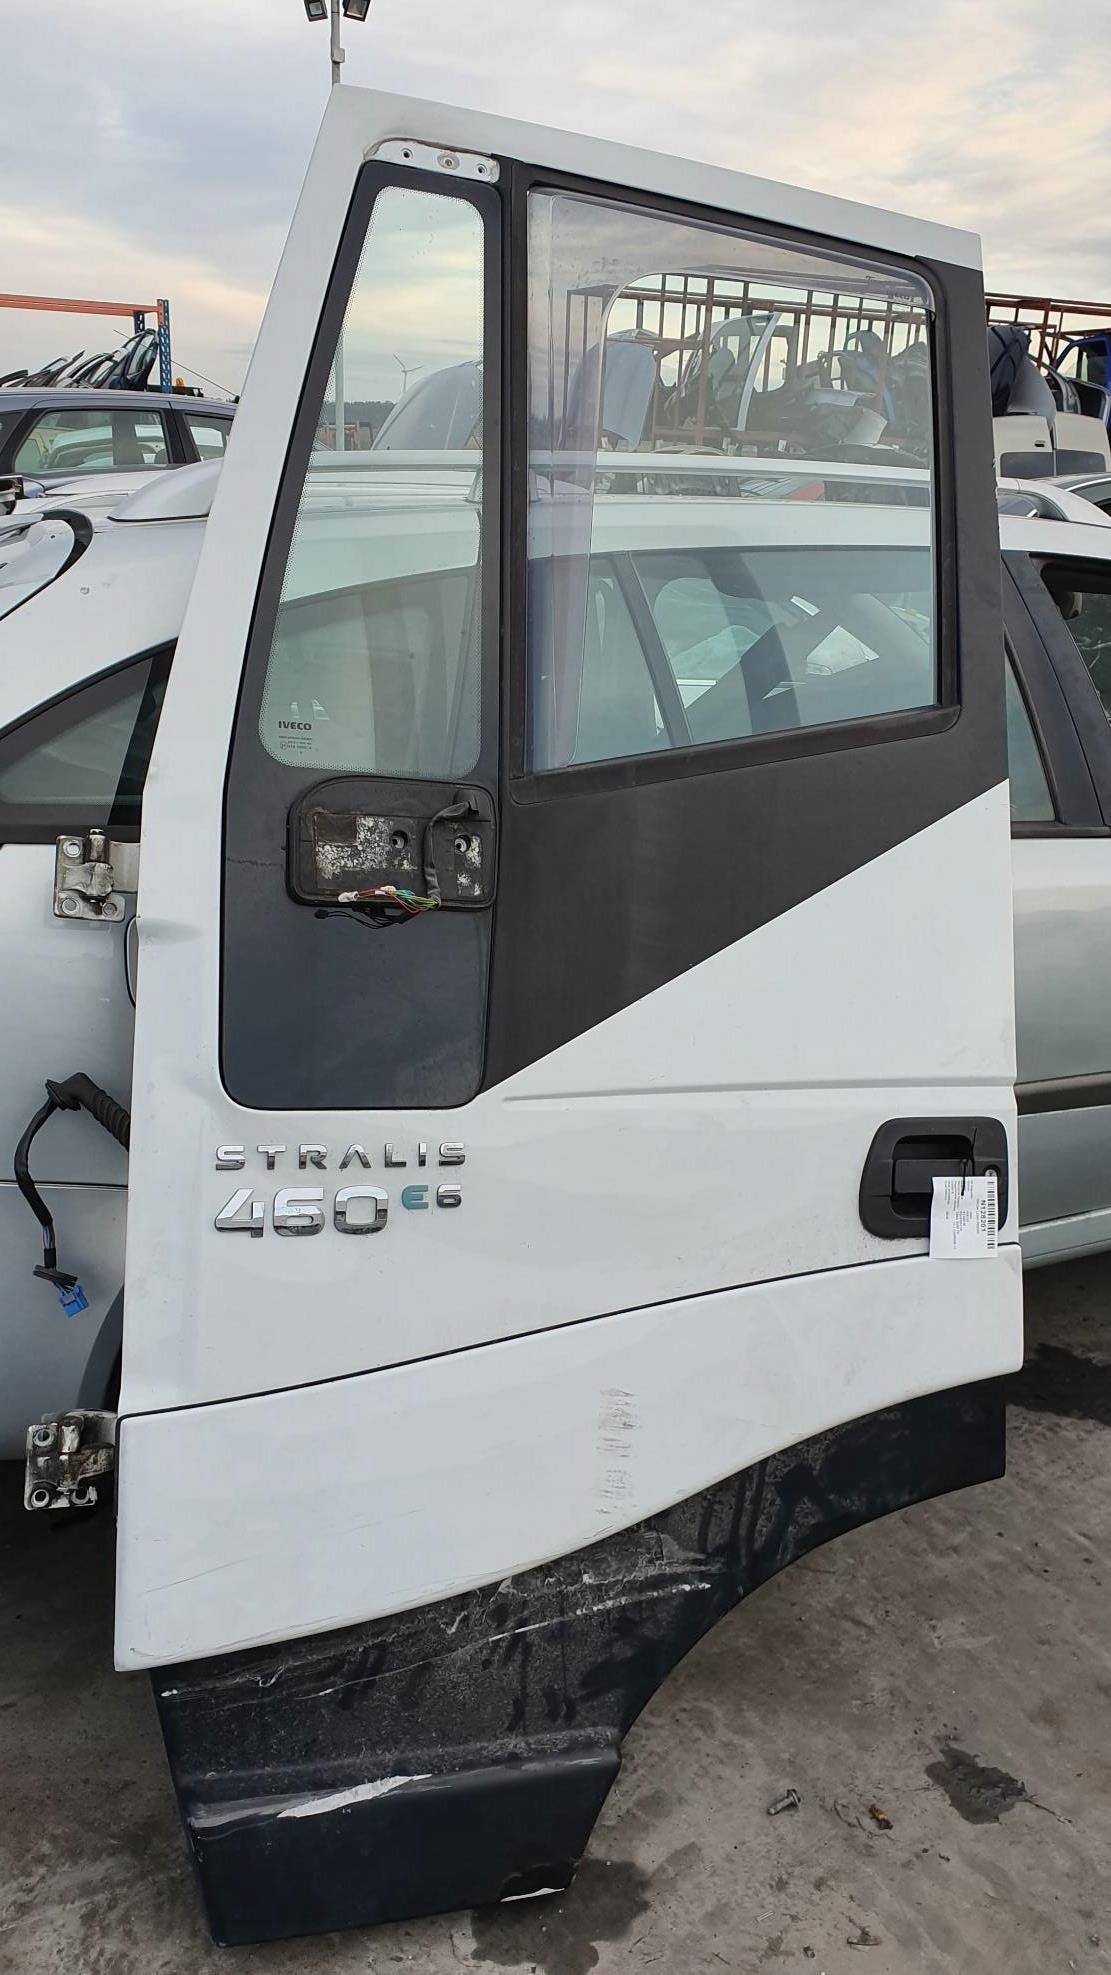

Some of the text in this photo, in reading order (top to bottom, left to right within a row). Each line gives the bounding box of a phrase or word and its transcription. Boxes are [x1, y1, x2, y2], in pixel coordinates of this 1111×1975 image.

[278, 720, 312, 731] IVECO
[215, 1142, 466, 1170] STRALIS
[214, 1184, 462, 1238] 460 E6
